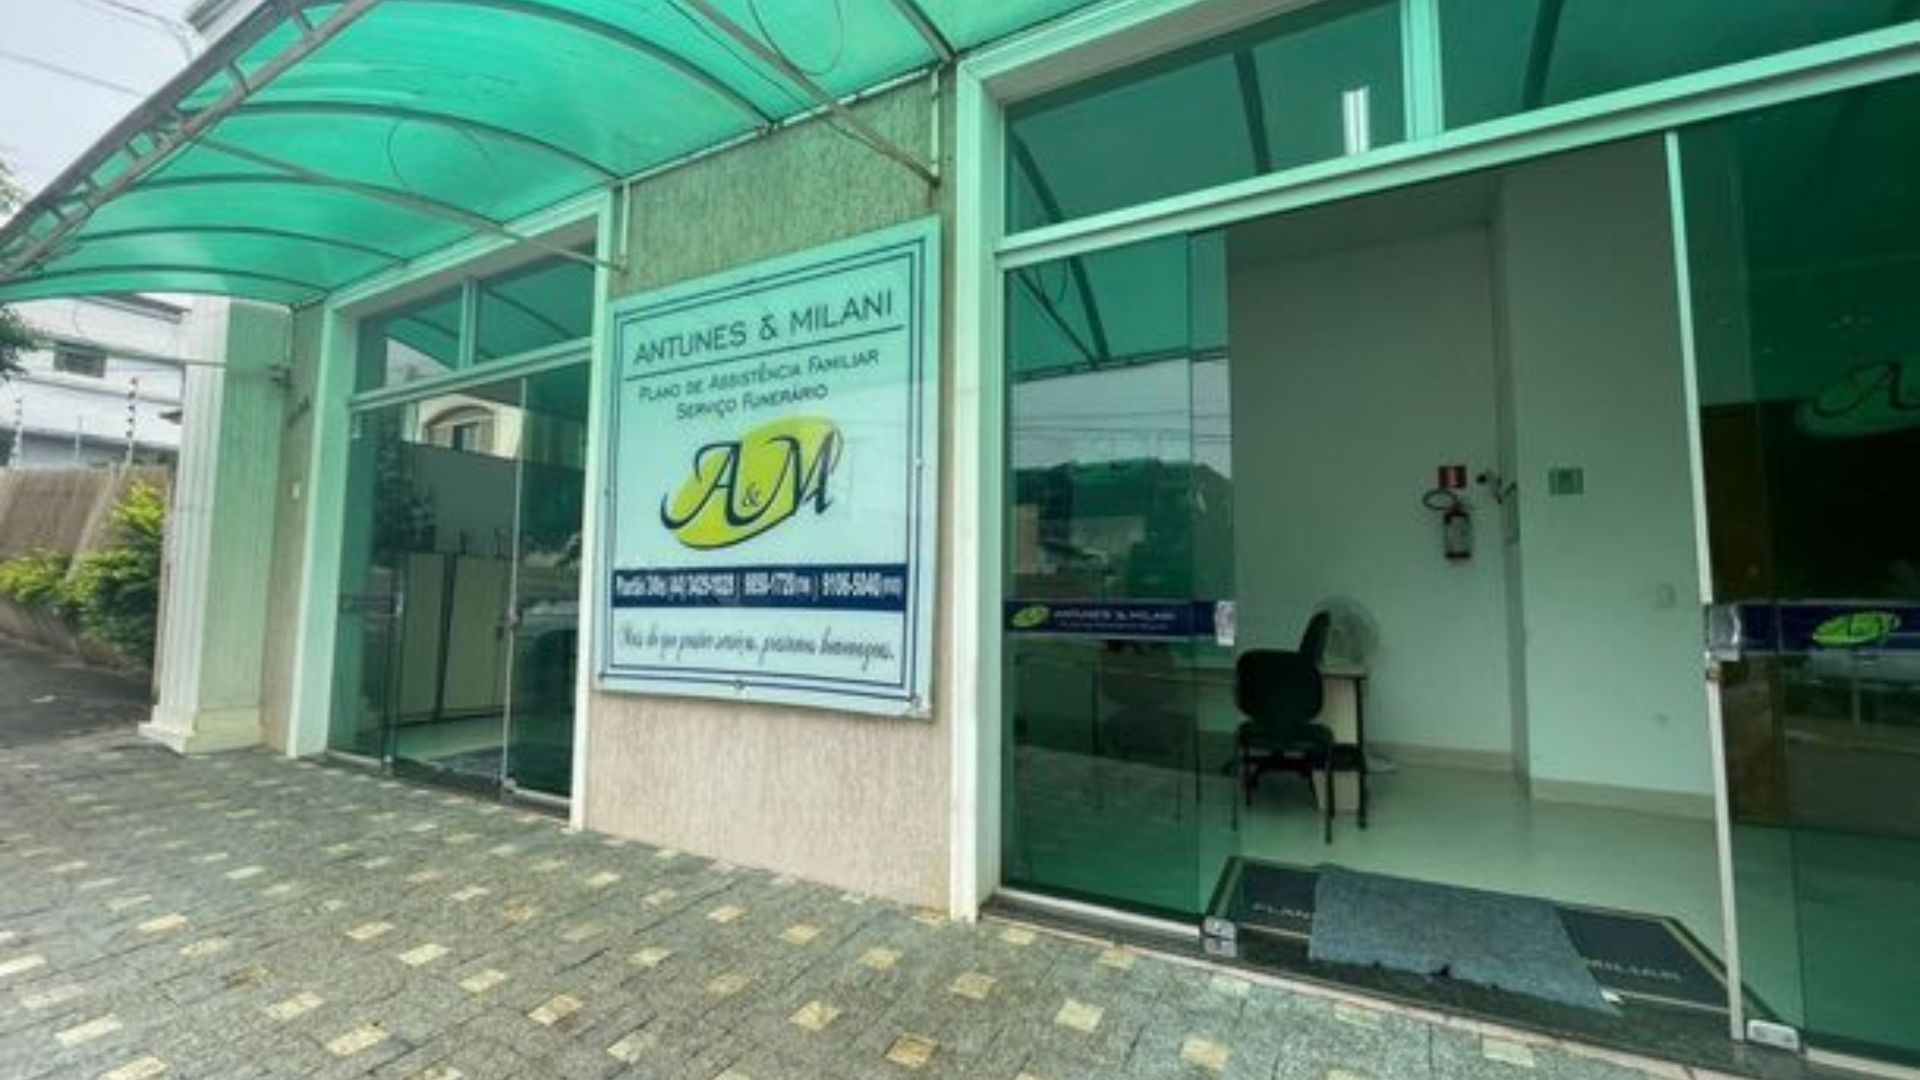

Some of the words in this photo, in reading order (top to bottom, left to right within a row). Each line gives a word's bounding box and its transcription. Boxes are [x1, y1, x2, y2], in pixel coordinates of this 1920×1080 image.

[633, 321, 747, 366] ANTUNES
[759, 314, 778, 341] &
[789, 288, 893, 334] MILANI
[639, 383, 681, 401] PLANO
[685, 380, 705, 396] DE
[808, 349, 880, 374] FAMILIAR
